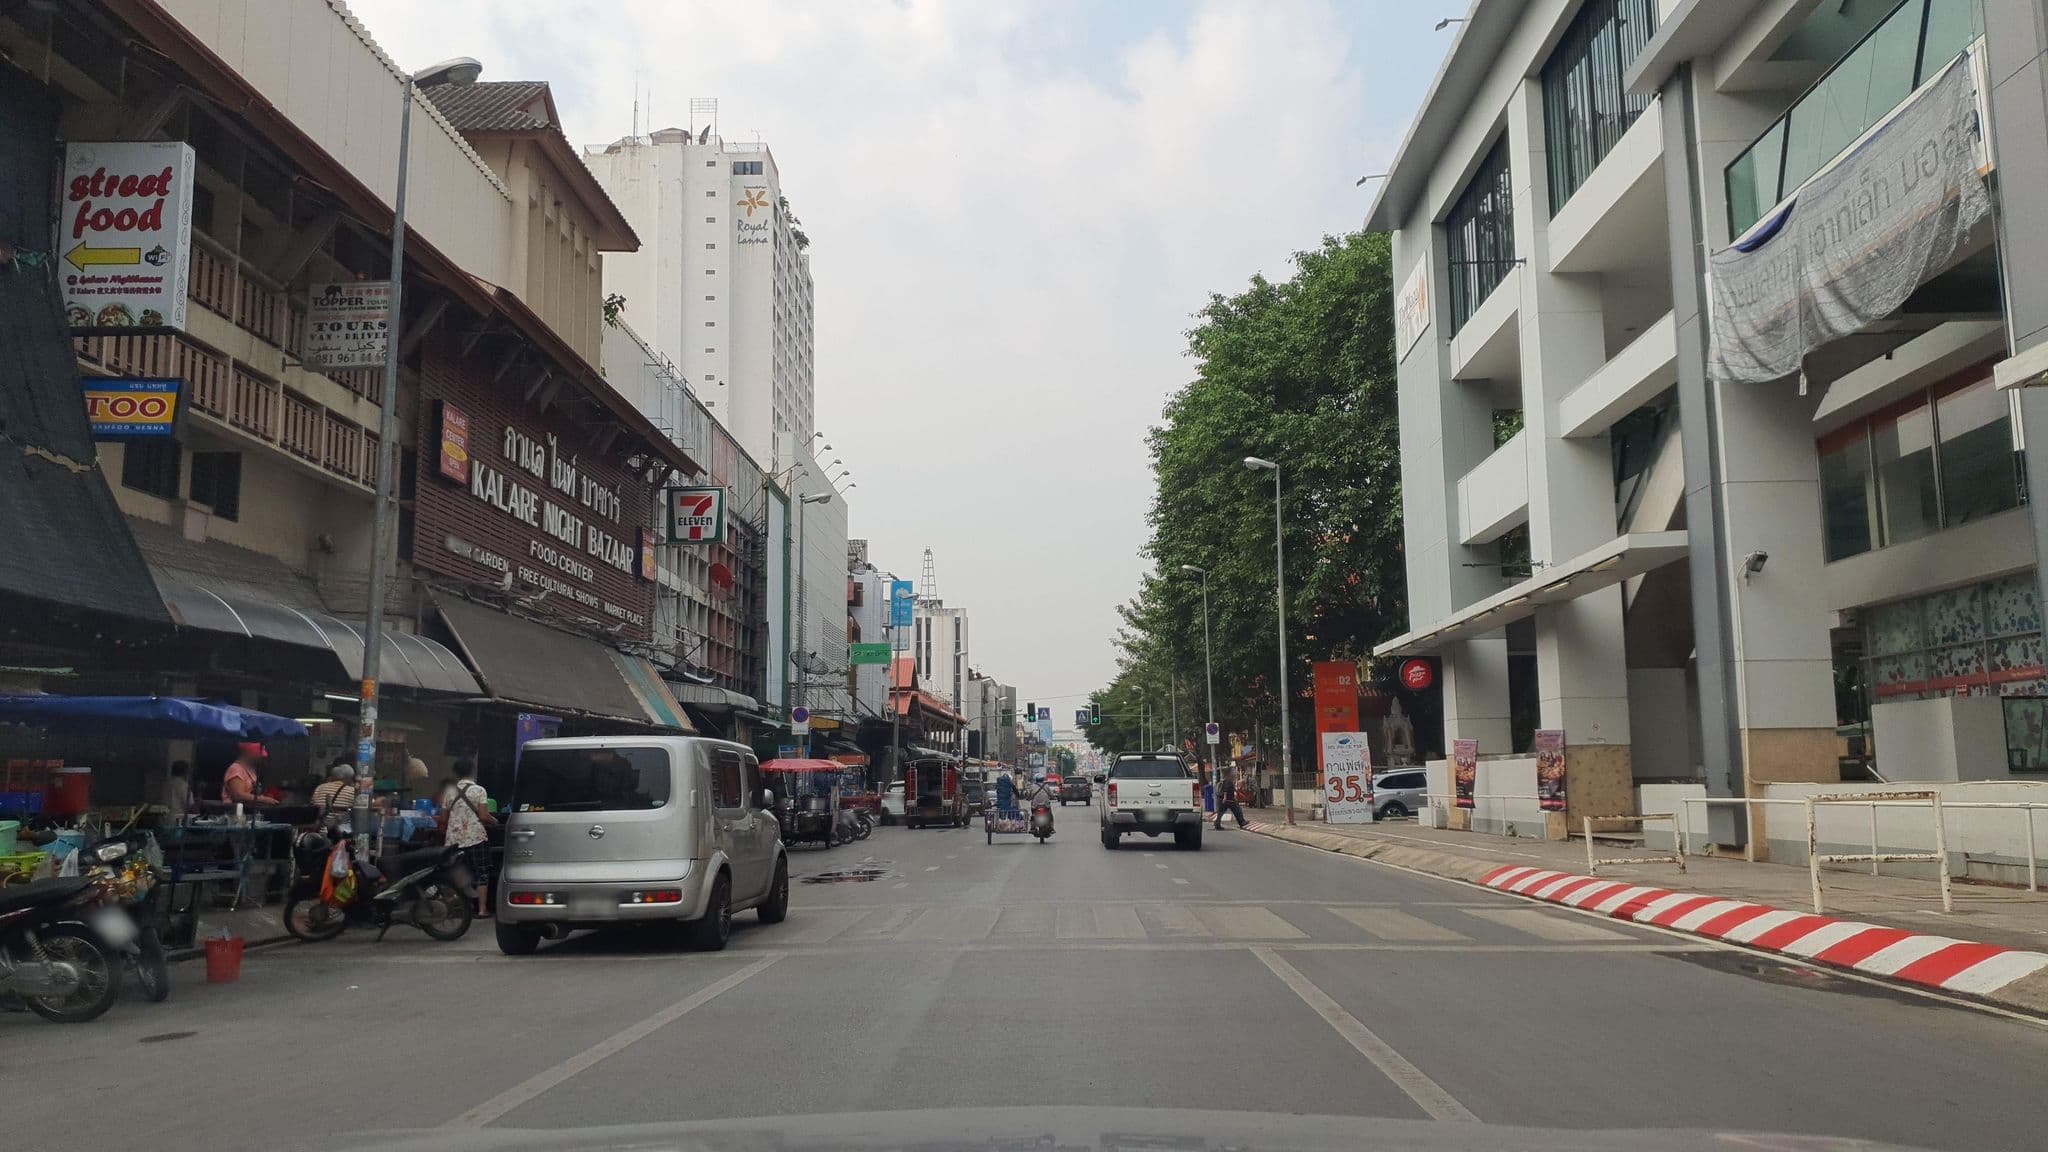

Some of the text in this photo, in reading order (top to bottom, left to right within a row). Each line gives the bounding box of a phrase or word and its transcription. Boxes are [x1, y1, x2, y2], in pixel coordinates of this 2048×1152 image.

[69, 166, 173, 201] street
[72, 198, 165, 239] food
[737, 219, 769, 235] Royal
[312, 297, 364, 306] TOPPER
[313, 321, 387, 332] TOURS
[504, 426, 621, 525] กาแล ไนท์ บาซาร์
[472, 460, 539, 528] KALARE
[542, 501, 584, 549] NIGHT
[587, 525, 635, 574] BAZAAR
[530, 540, 594, 583] FOOD CENTER
[475, 548, 644, 627] ARDEN FREE CULTURAL SHOWS MARKET PLACE
